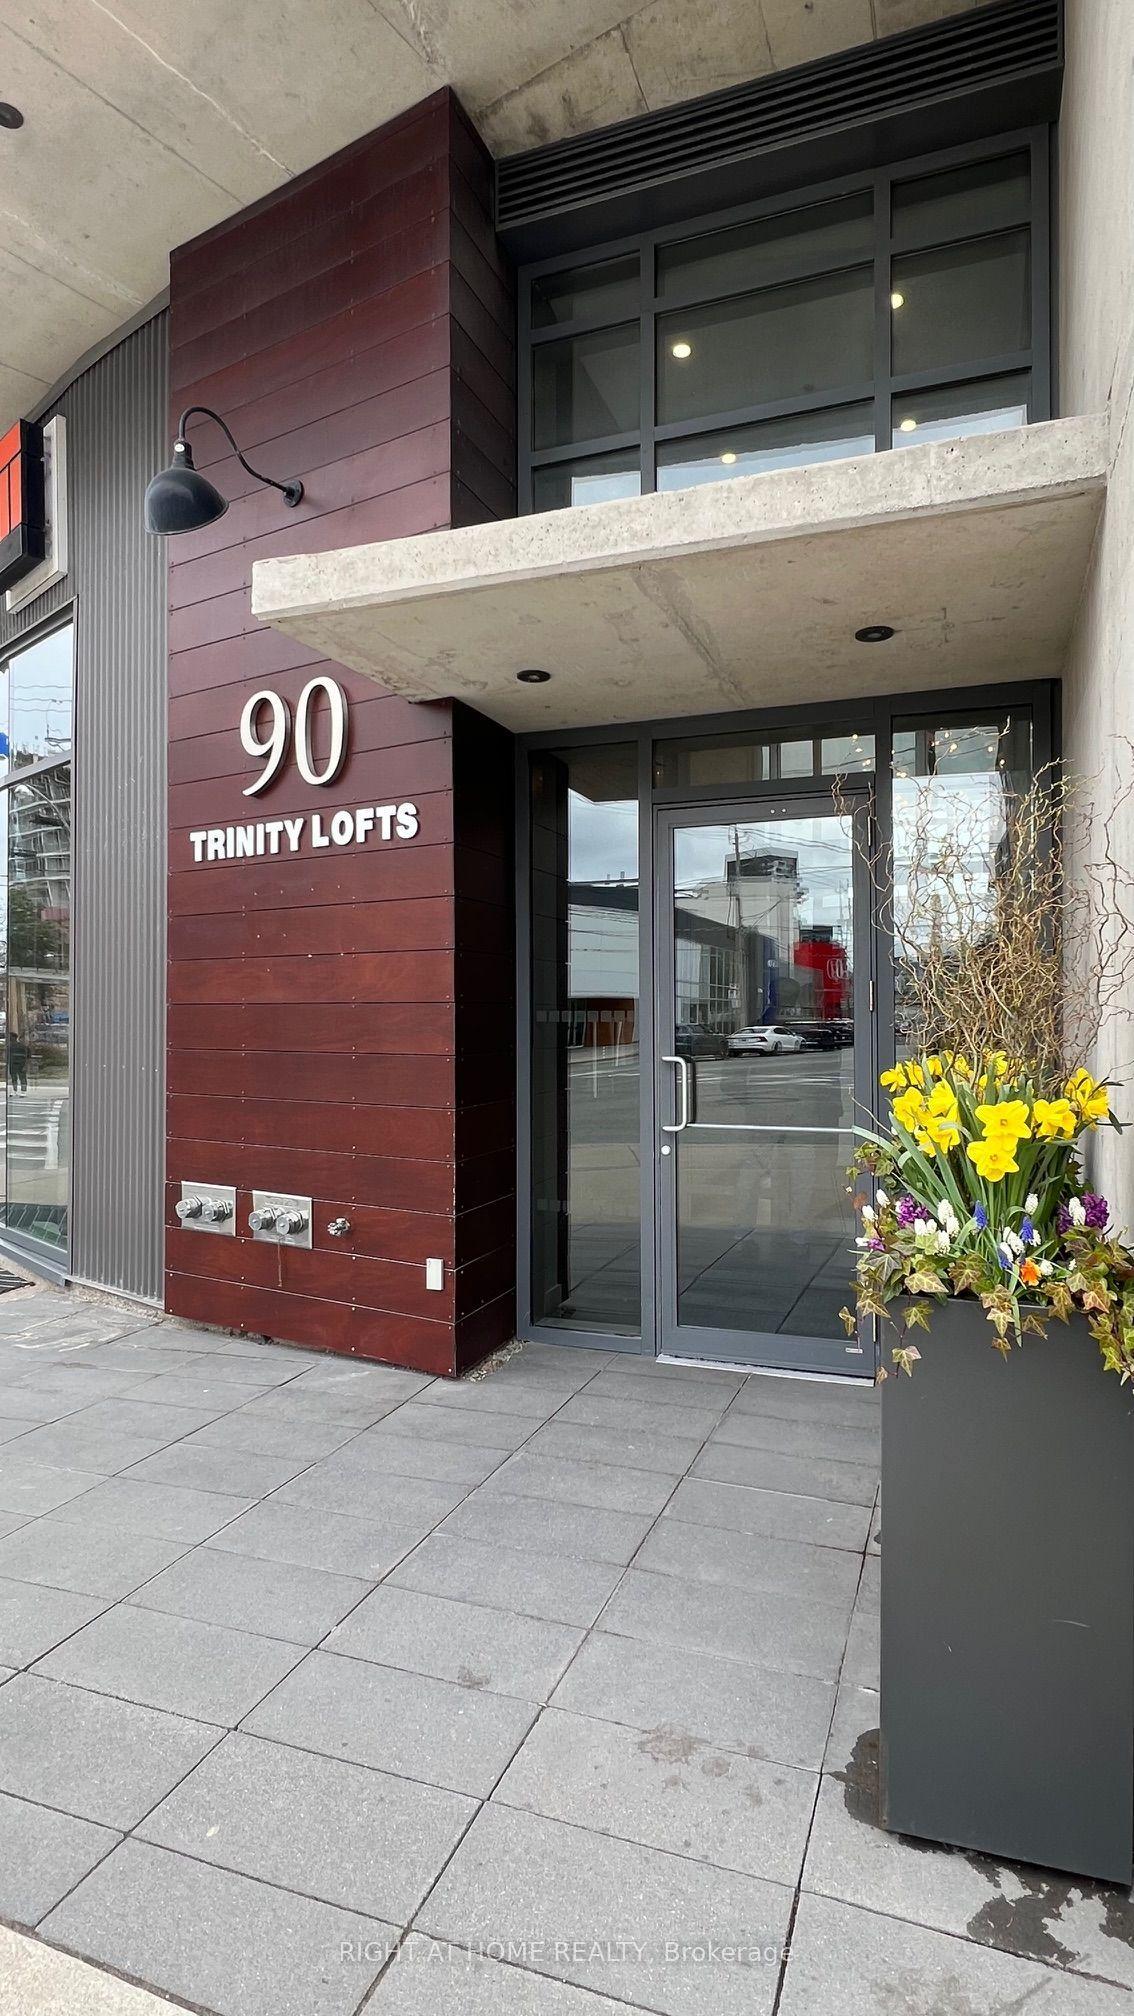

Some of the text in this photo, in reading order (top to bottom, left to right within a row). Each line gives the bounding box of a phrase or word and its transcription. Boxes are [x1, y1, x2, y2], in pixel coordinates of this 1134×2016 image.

[240, 676, 349, 797] 90
[190, 802, 419, 862] TRINITY LOFTS
